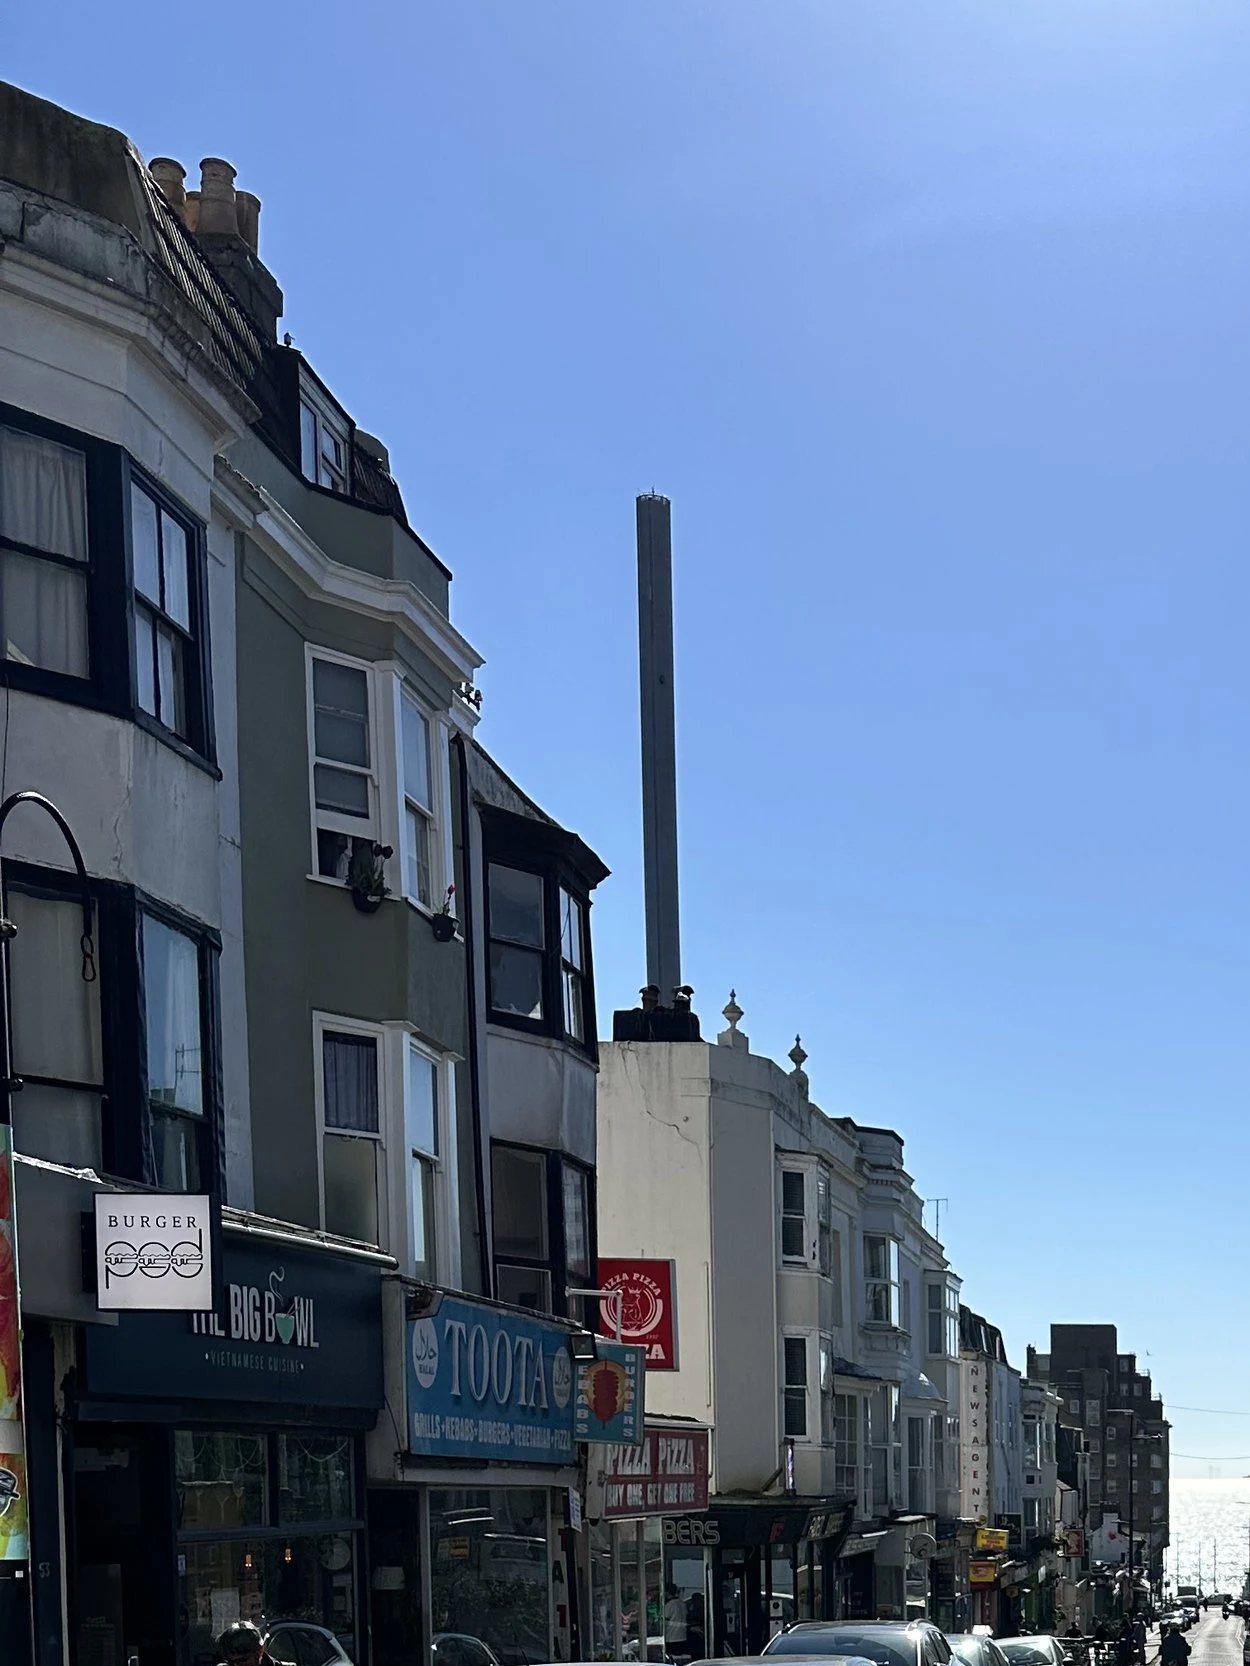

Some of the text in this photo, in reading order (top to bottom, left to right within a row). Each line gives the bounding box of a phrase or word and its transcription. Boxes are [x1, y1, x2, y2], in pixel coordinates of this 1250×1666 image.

[108, 1215, 197, 1228] BURGER
[632, 1272, 662, 1296] PIZZA
[229, 1283, 260, 1342] BIG
[211, 1350, 299, 1373] VIETNAMESE CUISINE
[444, 1319, 549, 1409] TOOTA
[576, 1365, 589, 1434] EBABS
[624, 1353, 636, 1437] BURGERS
[414, 1412, 441, 1439] GRILLS
[445, 1416, 475, 1442] KEBABS
[554, 1428, 571, 1451] PIZZ
[970, 1366, 981, 1513] NEWSAGENT
[607, 1438, 651, 1476] PIZZA
[607, 1484, 624, 1508] BUY
[648, 1483, 662, 1506] GET
[664, 1483, 678, 1505] ONE
[663, 1520, 721, 1545] BERS
